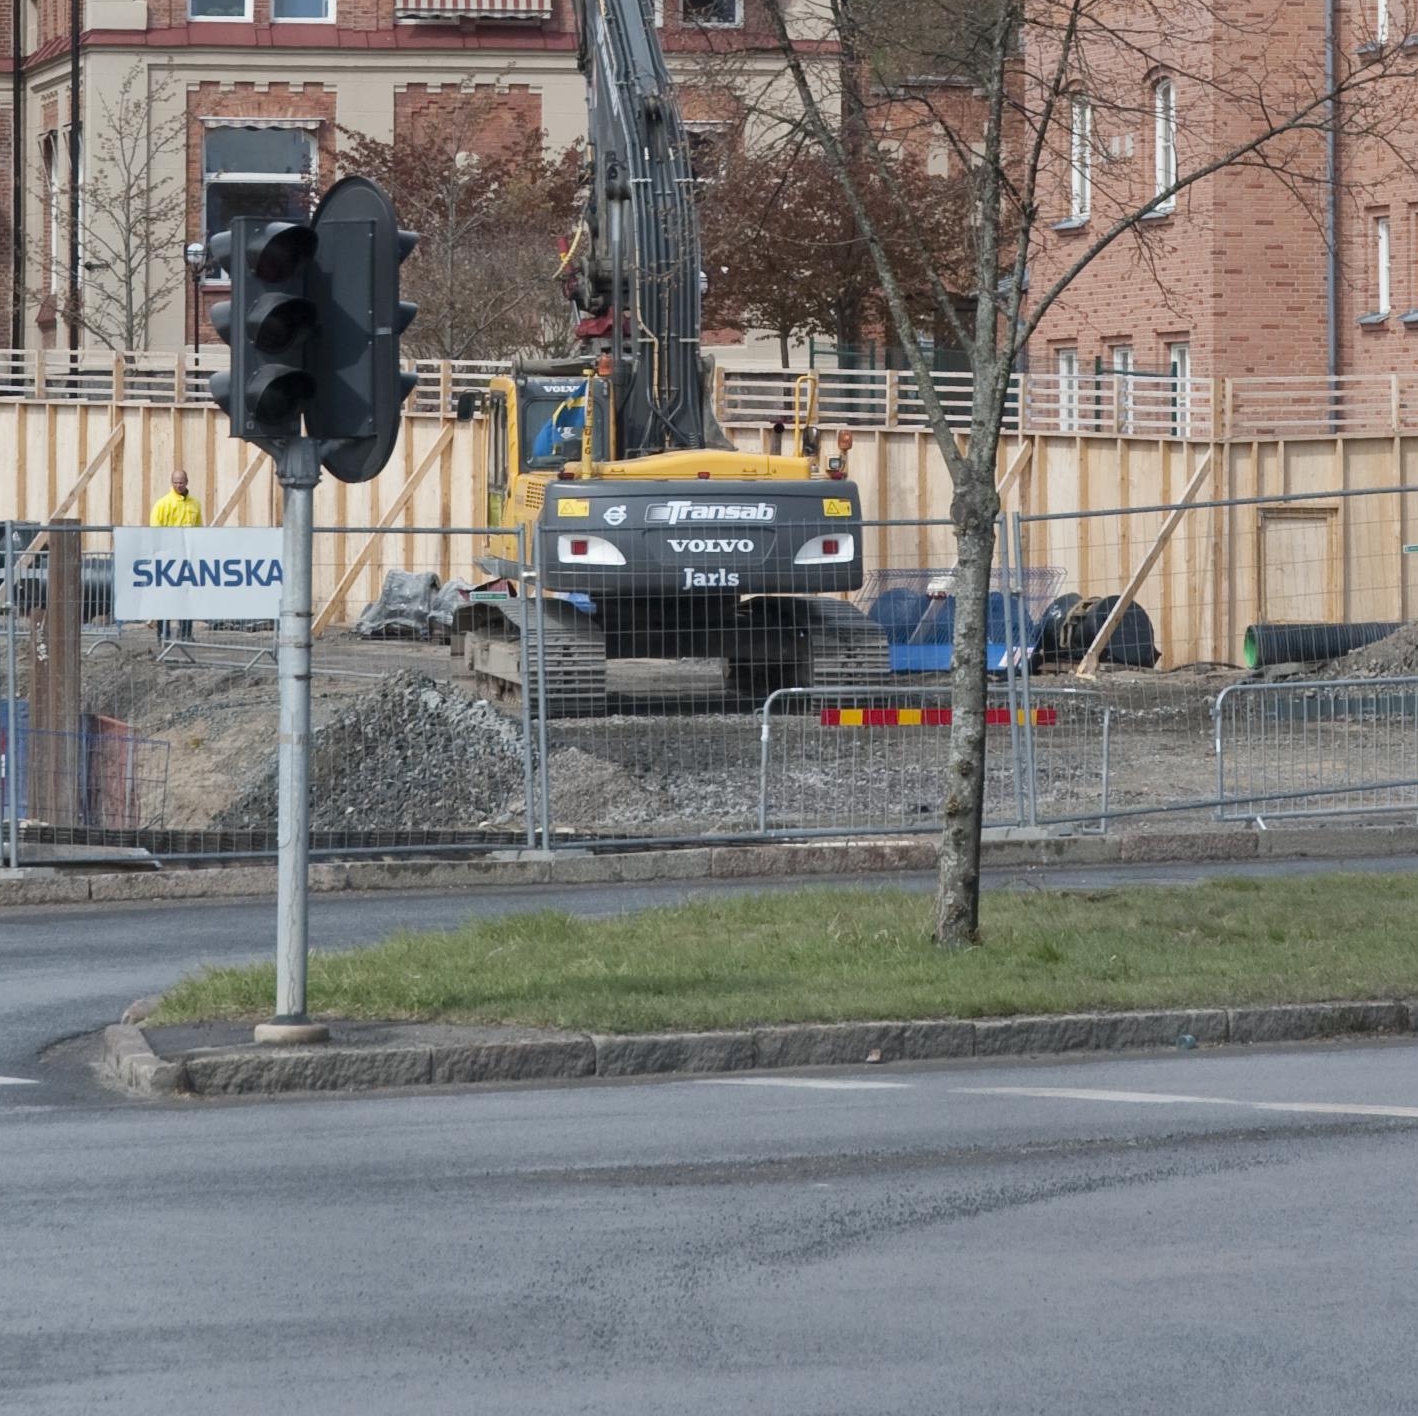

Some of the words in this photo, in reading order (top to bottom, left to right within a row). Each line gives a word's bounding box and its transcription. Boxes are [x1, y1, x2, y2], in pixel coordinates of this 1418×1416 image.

[542, 385, 580, 393] VOLV
[667, 501, 774, 525] Transab
[667, 539, 755, 553] VOLVO
[133, 559, 284, 587] SKANSKA
[682, 568, 740, 590] Jarls
